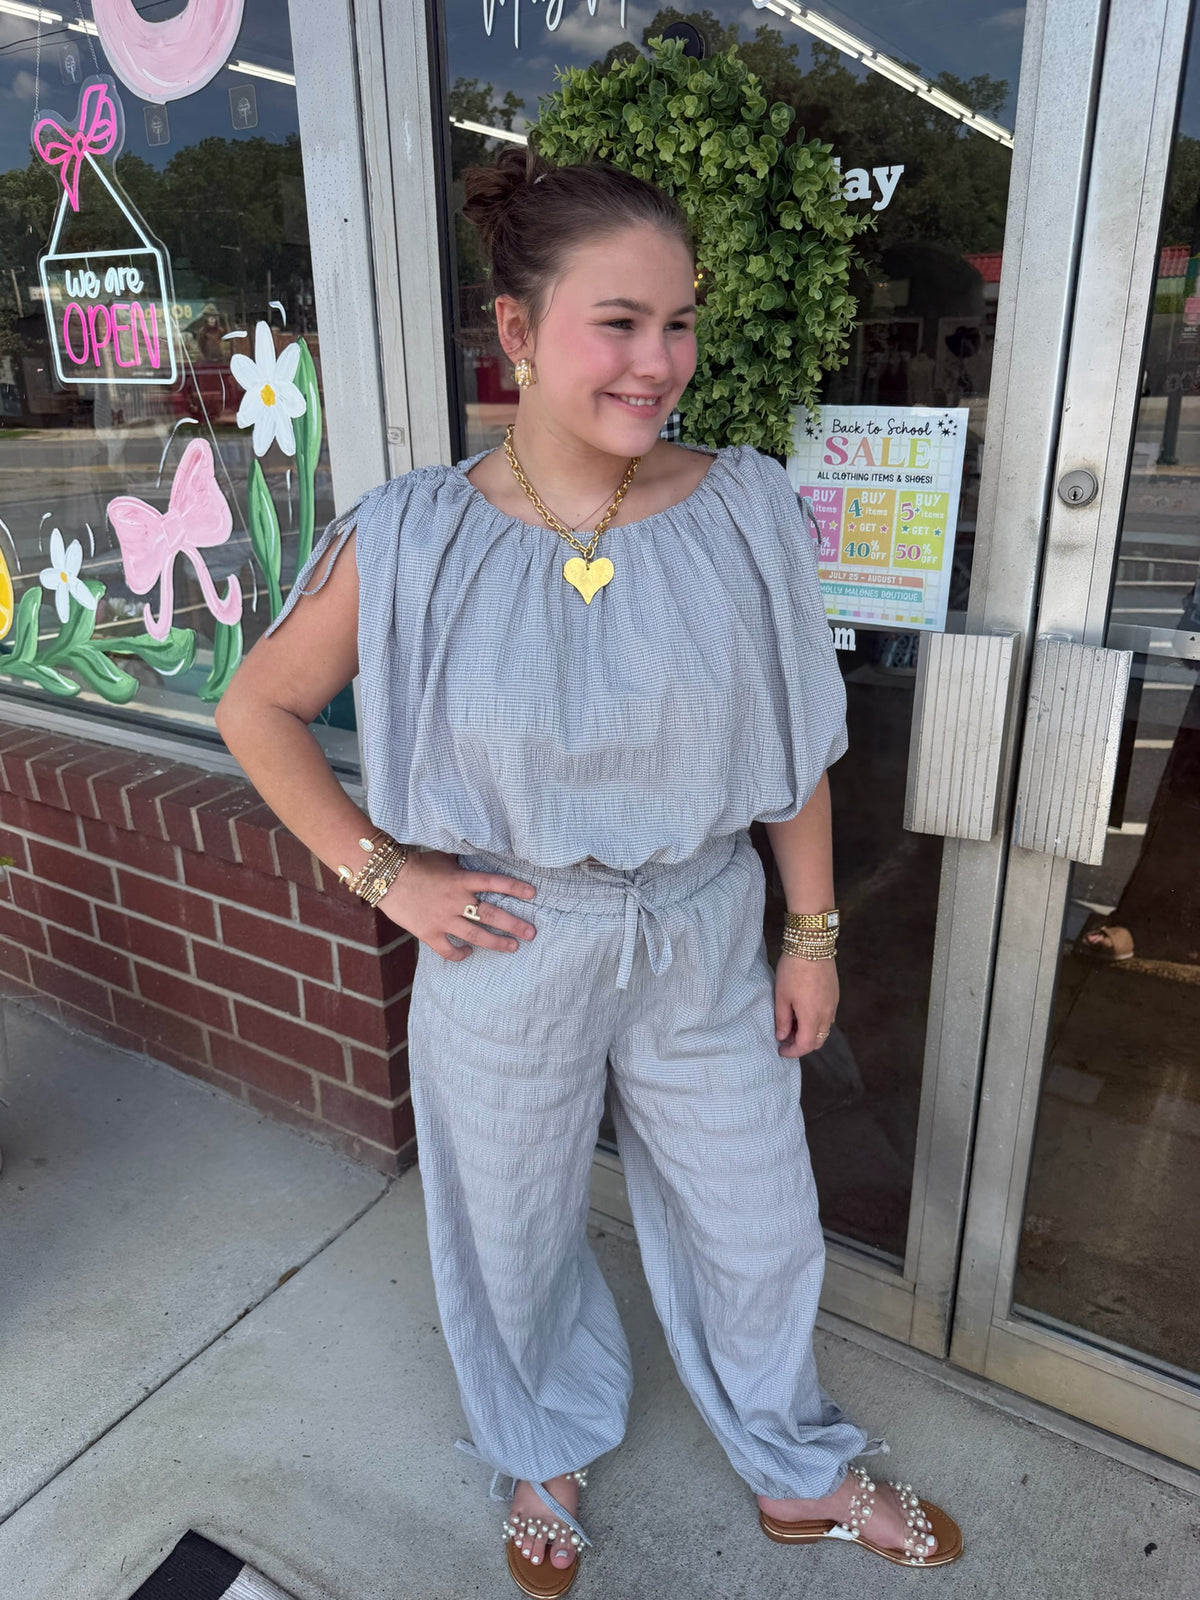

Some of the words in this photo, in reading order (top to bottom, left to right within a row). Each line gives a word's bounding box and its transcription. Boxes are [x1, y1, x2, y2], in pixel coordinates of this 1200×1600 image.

[105, 266, 144, 296] are
[63, 301, 160, 369] OPEN
[832, 418, 865, 434] Back
[866, 420, 882, 434] to
[887, 417, 933, 436] School
[823, 435, 932, 469] SALE
[817, 471, 830, 480] ALL
[832, 471, 869, 481] CLOTHING
[871, 473, 894, 482] ITEMS
[896, 474, 902, 482] &
[904, 474, 933, 484] SHOES!
[813, 489, 836, 502] BUY
[861, 490, 886, 504] BUY
[915, 493, 942, 507] BUY
[815, 503, 837, 513] items
[848, 498, 863, 518] 4
[865, 507, 888, 516] items
[921, 510, 944, 519] items
[860, 523, 876, 532] GET
[912, 525, 930, 535] GET
[820, 548, 836, 557] OFF
[870, 551, 887, 560] OFF
[921, 555, 938, 564] OFF
[828, 570, 846, 580] JULY
[848, 572, 859, 580] 25
[867, 574, 897, 584] AUGUST
[820, 584, 844, 593] MOLLY
[845, 586, 880, 598] MALONES
[881, 590, 919, 601] BOUTIQUE
